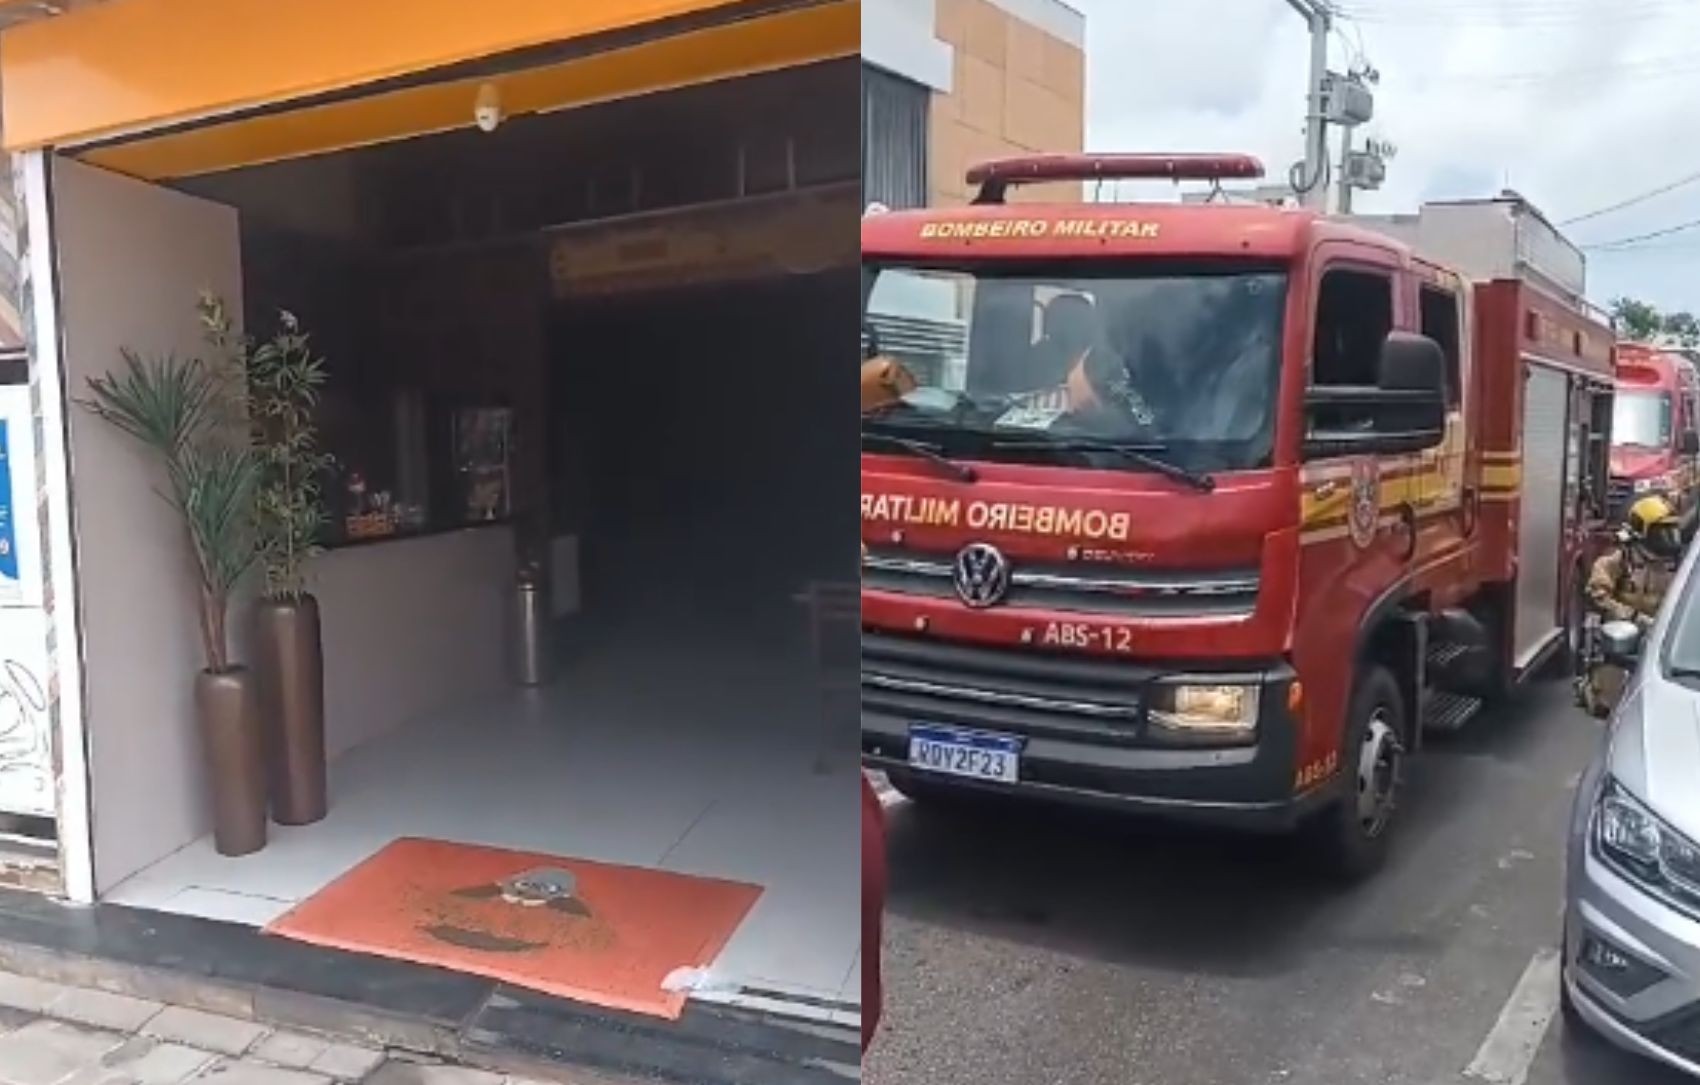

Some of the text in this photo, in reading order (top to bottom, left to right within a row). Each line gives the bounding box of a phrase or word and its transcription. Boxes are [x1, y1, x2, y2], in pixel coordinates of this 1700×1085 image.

[920, 219, 1160, 238] BOMBEIRO MILITAR
[1044, 621, 1132, 652] ABS-12
